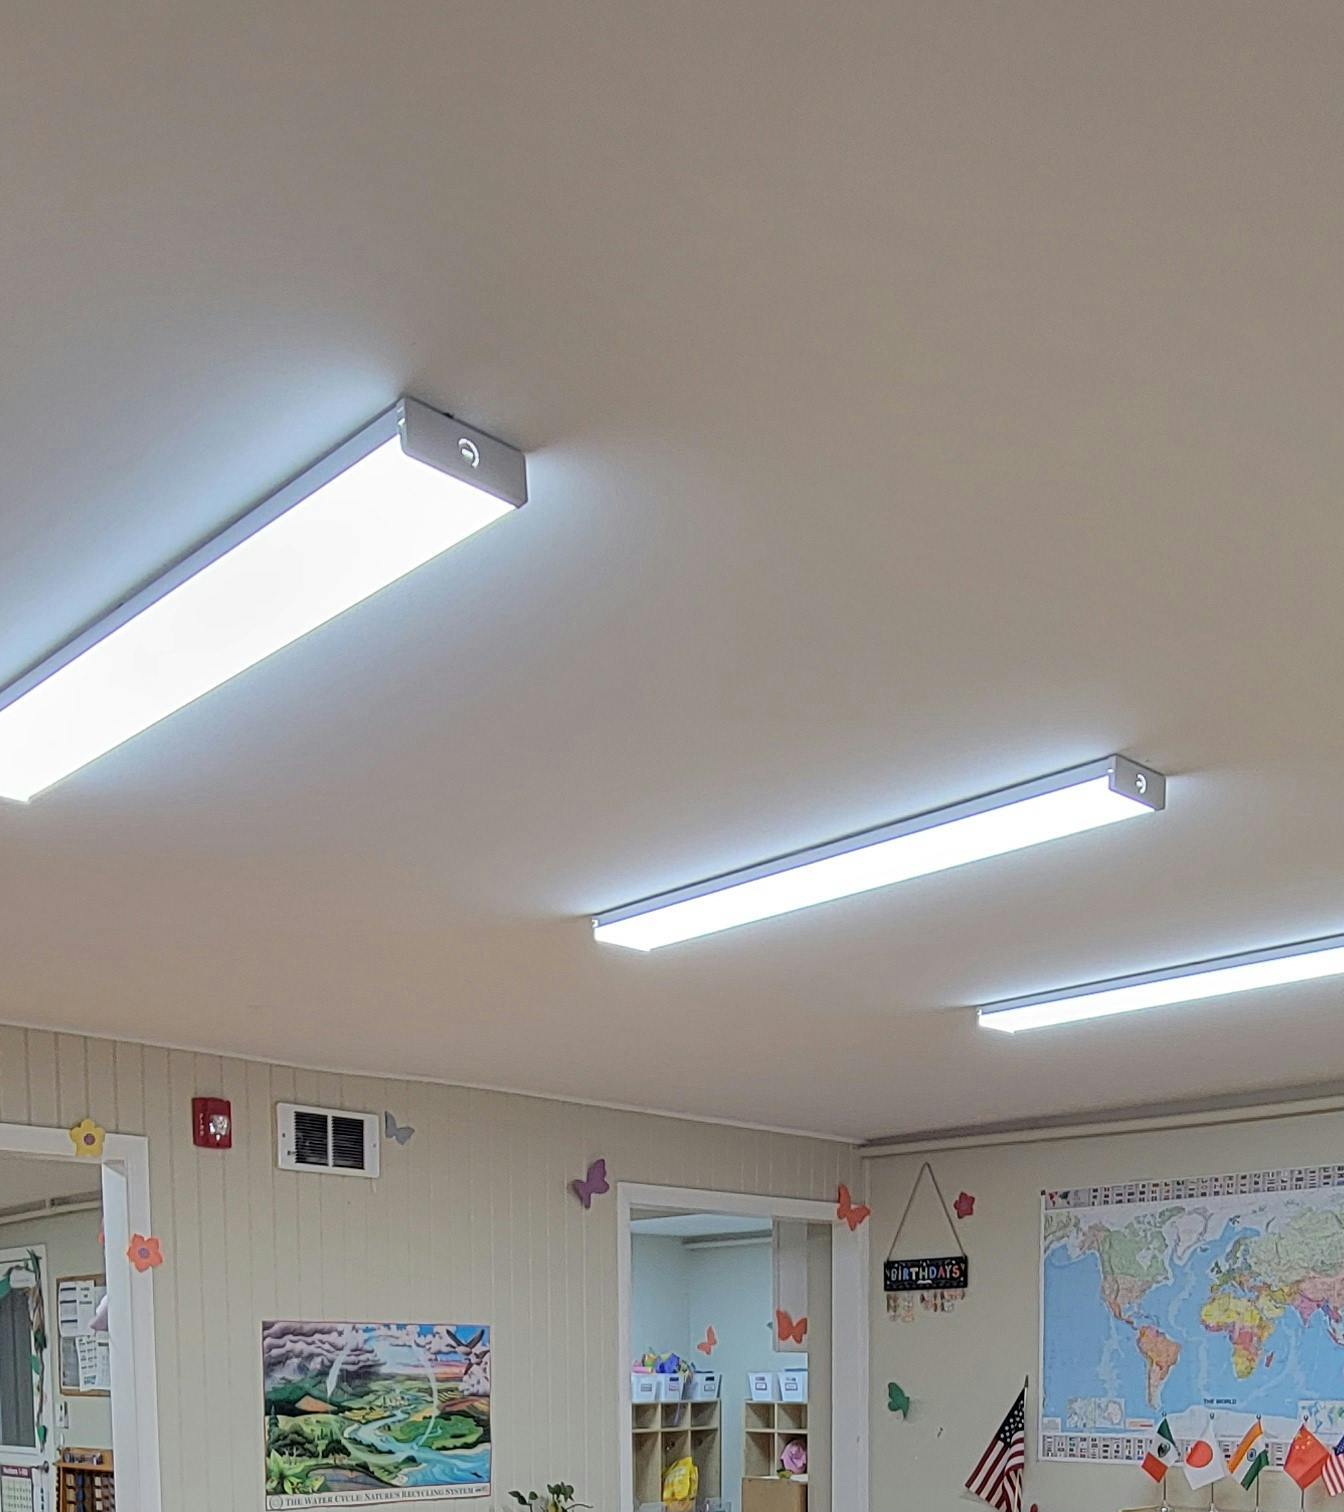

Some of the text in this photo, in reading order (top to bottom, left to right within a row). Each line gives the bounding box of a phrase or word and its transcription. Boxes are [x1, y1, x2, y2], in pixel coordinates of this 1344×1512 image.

[891, 1264, 960, 1281] BIRTHDAYS
[286, 1498, 304, 1506] THE
[304, 1495, 333, 1506] WATER
[401, 1489, 444, 1499] RECYCLING
[445, 1487, 474, 1496] SYSTEM
